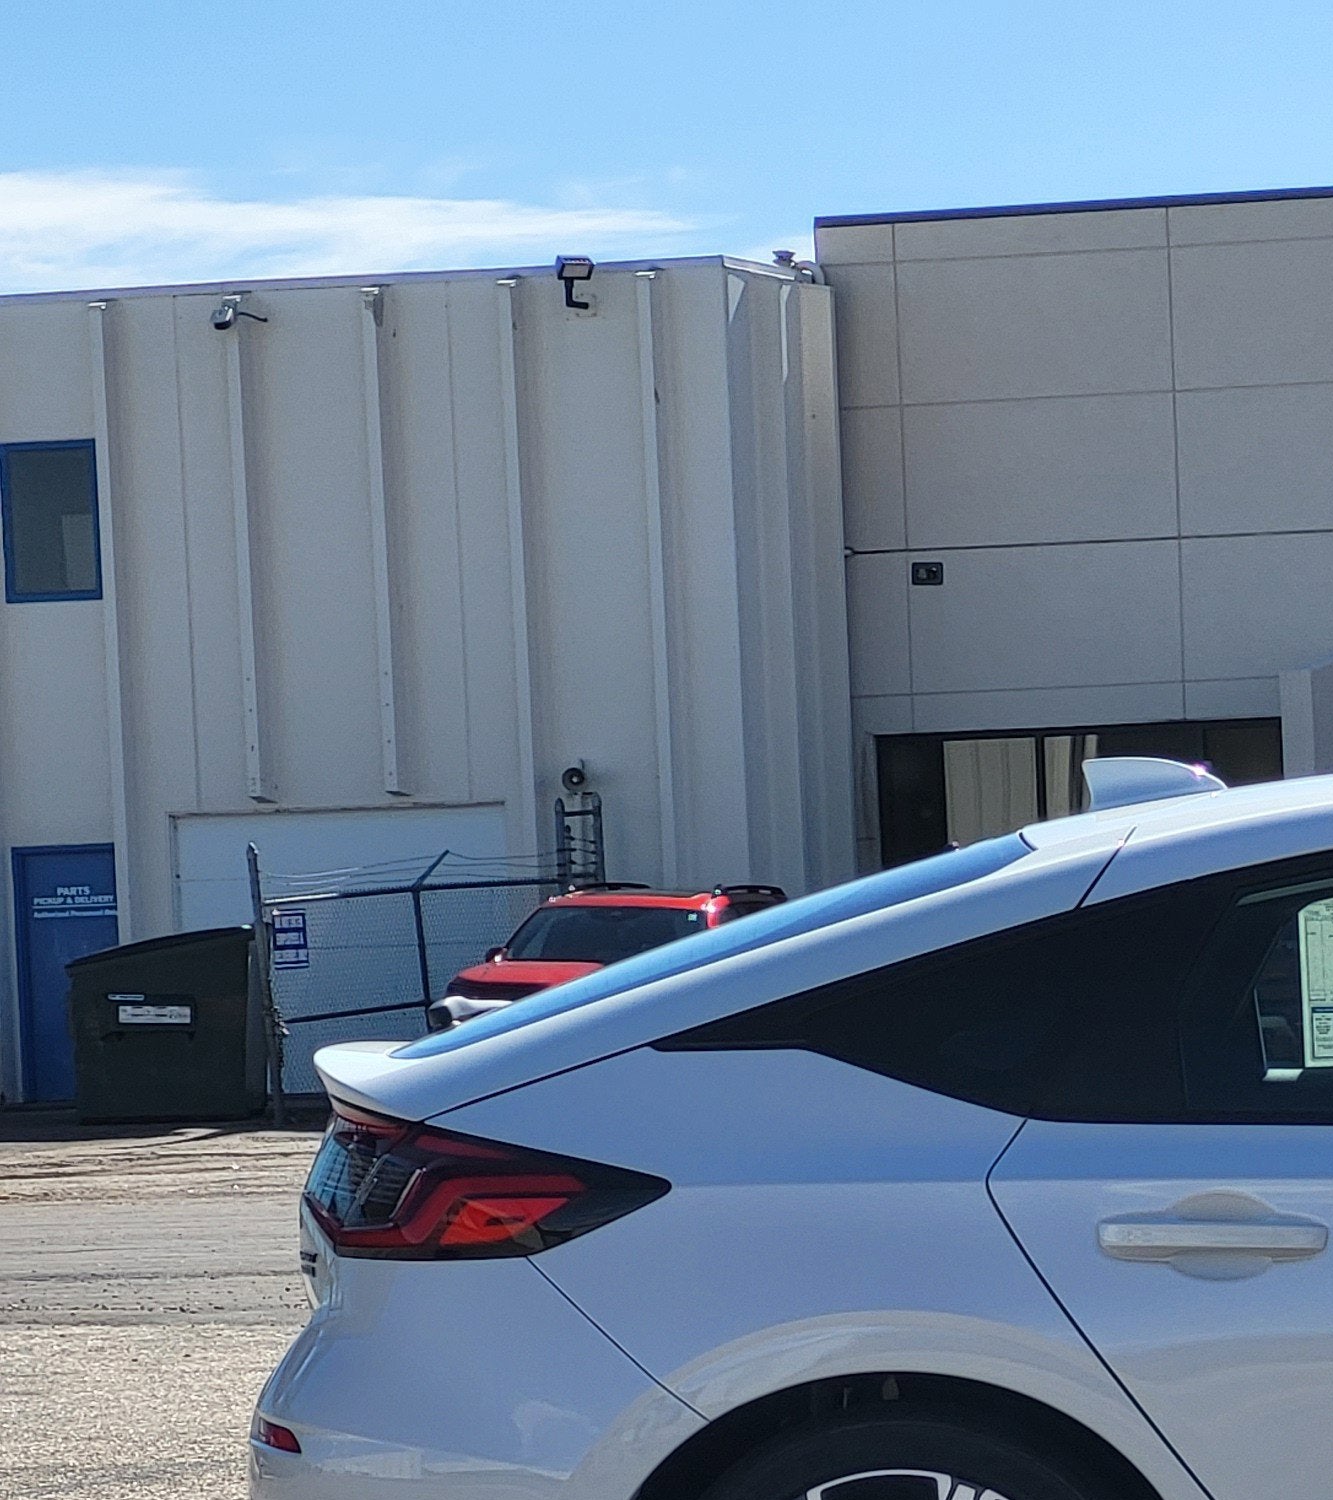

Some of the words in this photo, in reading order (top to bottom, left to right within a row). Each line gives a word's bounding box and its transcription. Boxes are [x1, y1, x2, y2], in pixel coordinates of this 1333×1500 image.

[56, 886, 91, 896] PARTS
[33, 897, 64, 905] PICKUP
[74, 895, 114, 904] DELIVERY
